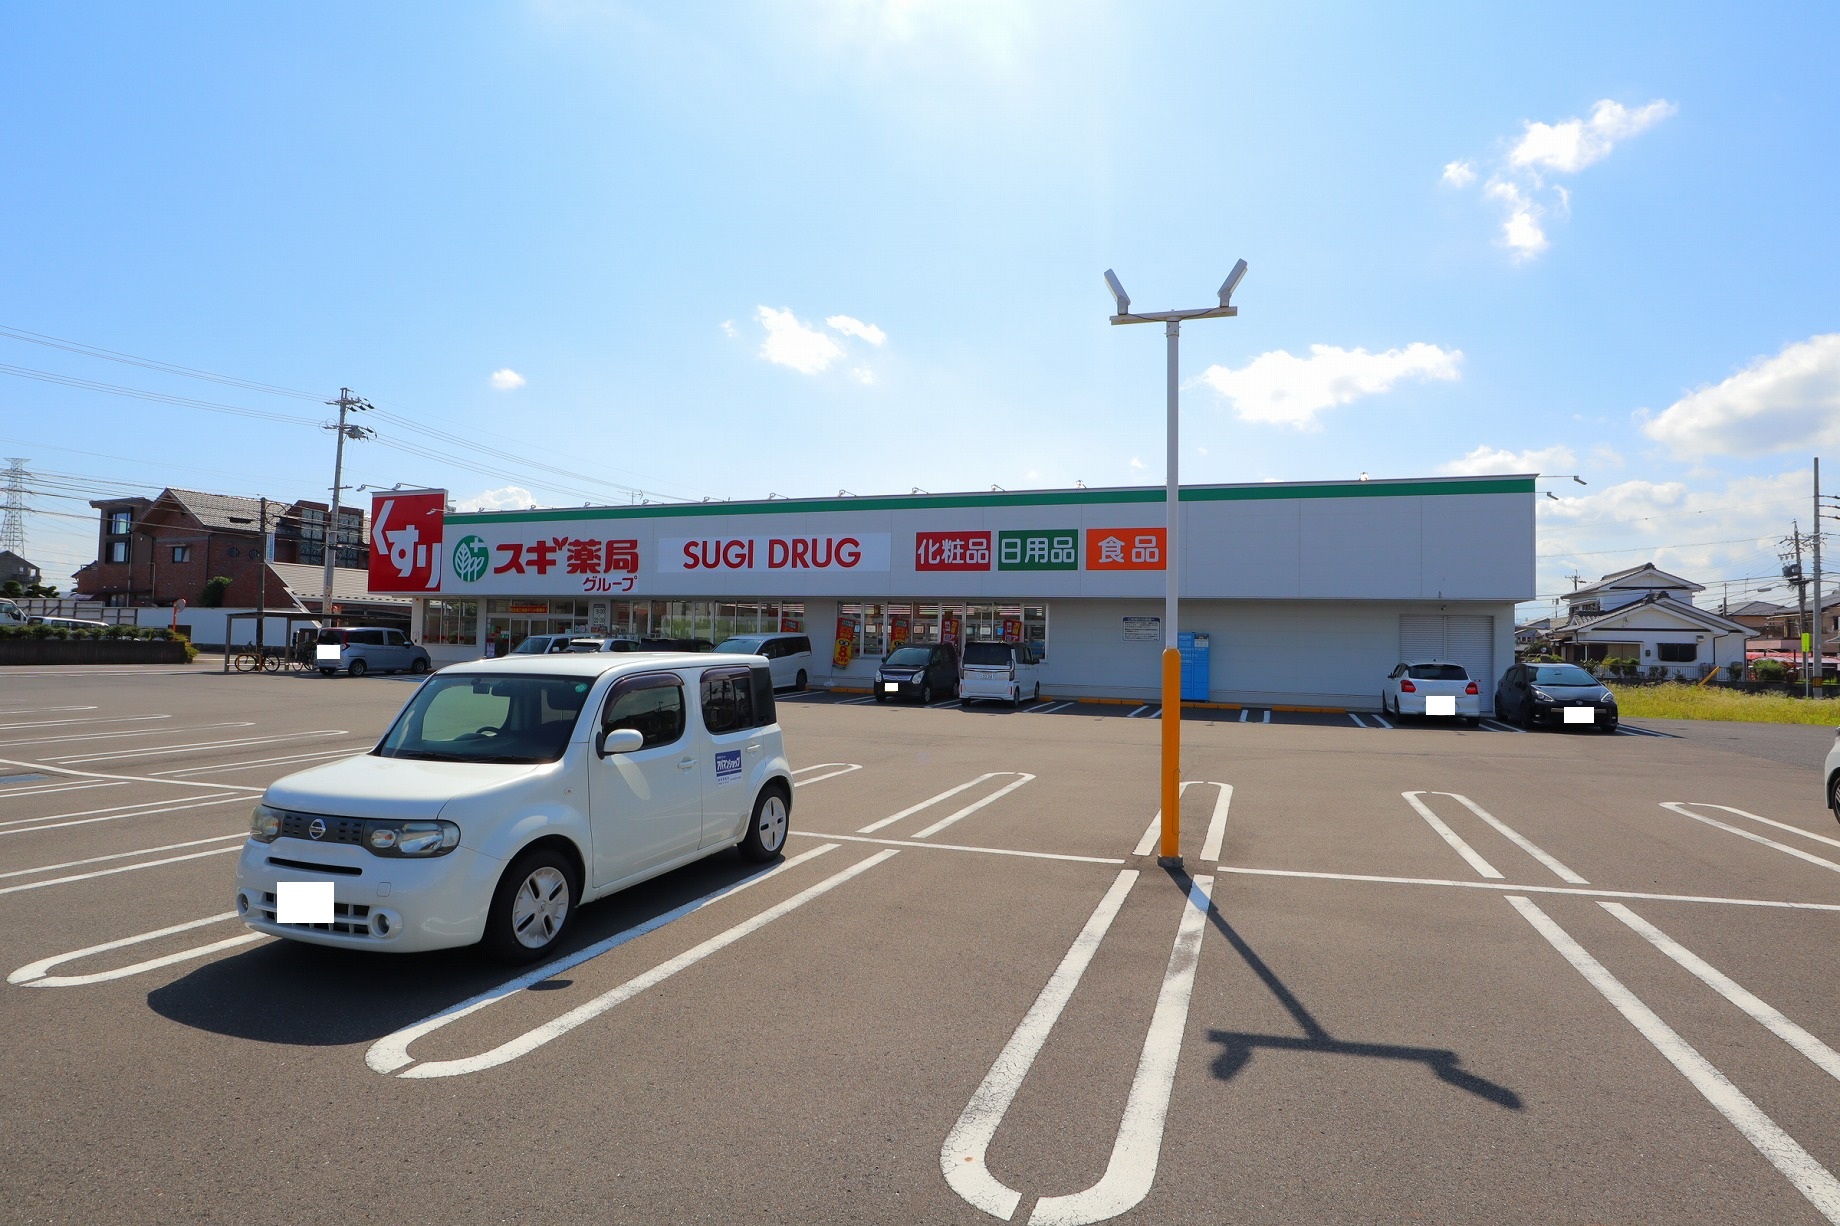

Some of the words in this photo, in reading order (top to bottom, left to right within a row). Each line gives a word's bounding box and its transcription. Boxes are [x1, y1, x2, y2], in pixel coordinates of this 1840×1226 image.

[371, 499, 442, 589] くすり
[493, 536, 639, 575] スギ薬局
[683, 539, 754, 569] SUGI
[767, 537, 861, 569] DRUG
[917, 538, 989, 565] 化粧品
[1001, 537, 1075, 563] 日用品
[1098, 535, 1159, 563] 食品
[582, 575, 638, 592] グループ
